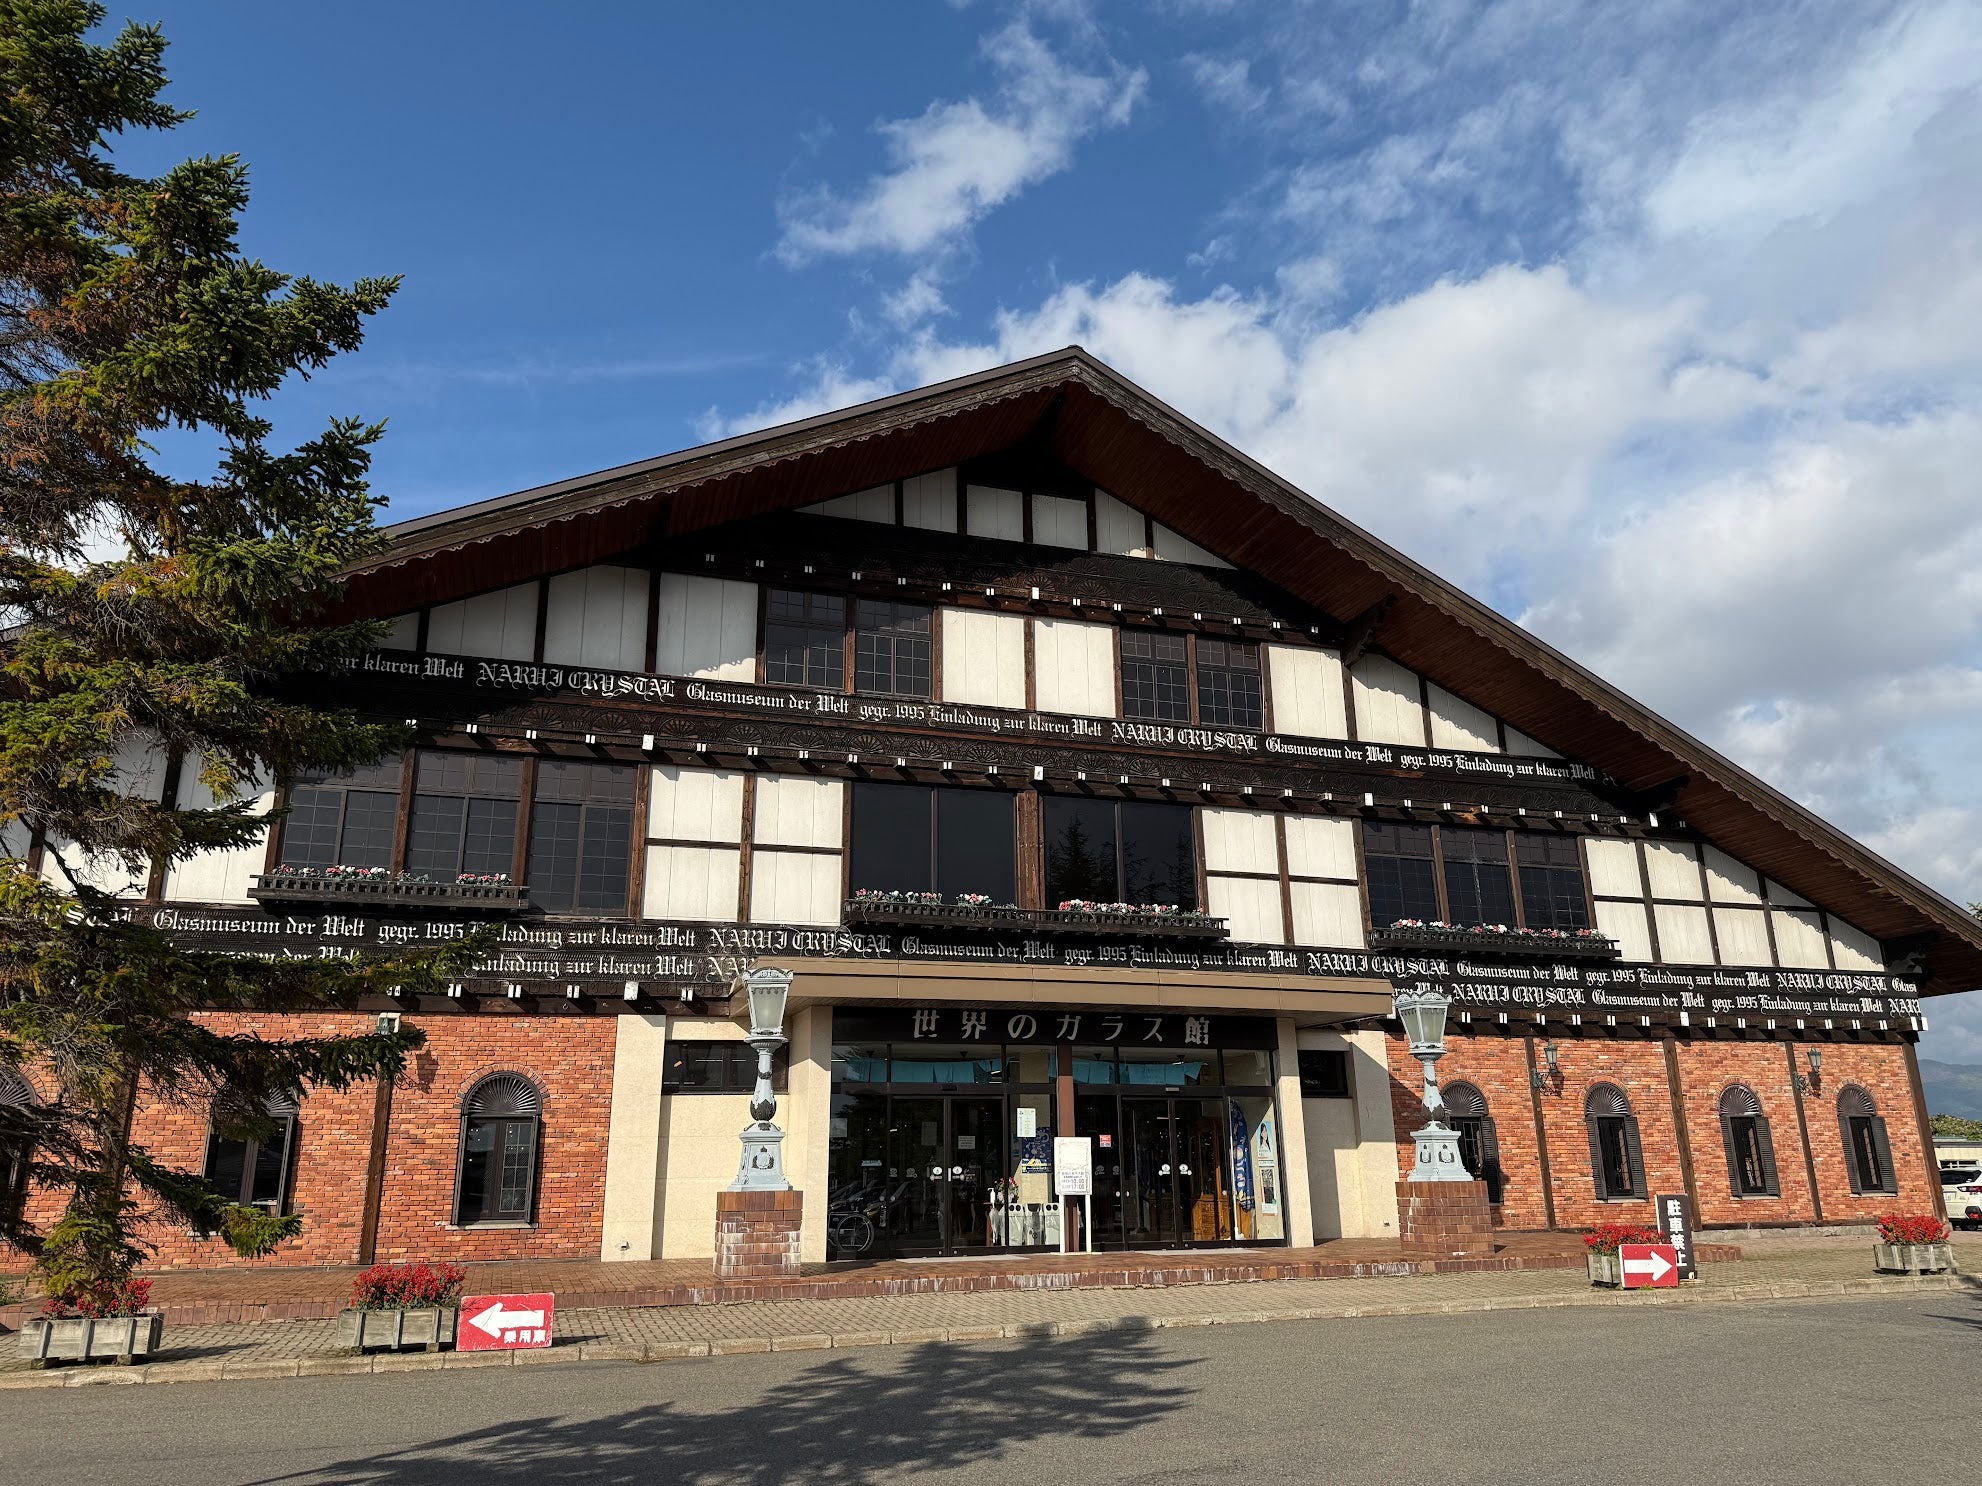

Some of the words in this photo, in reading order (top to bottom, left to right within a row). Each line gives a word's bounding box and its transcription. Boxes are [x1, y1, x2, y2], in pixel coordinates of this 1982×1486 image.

[337, 654, 359, 671] ur
[364, 654, 419, 674] klaren
[423, 655, 465, 679] Welt
[568, 672, 675, 702] CRYSTAL
[686, 682, 784, 708] Glasmuseum
[789, 695, 811, 710] der
[815, 693, 850, 715] Welt
[929, 702, 1000, 731] Einladung
[1004, 719, 1025, 729] zur
[1029, 714, 1070, 733] klaren
[1071, 717, 1101, 739] Welt
[1177, 728, 1258, 754] CRYSTAL
[1266, 735, 1343, 758] Glasmuseum
[1345, 746, 1362, 760] der
[1365, 746, 1392, 764] Welt
[1454, 752, 1514, 778] Einladung
[1516, 765, 1533, 774] zur
[1536, 762, 1569, 777] klaren
[1570, 764, 1595, 781] Welt
[153, 908, 279, 935] Glasmuseum
[285, 917, 316, 935] der
[320, 915, 365, 940] Welt
[565, 930, 598, 944] zur
[599, 924, 655, 945] klaren
[655, 927, 695, 950] Welt
[792, 931, 891, 958] CRYSTAL
[900, 938, 993, 959] Glasmuseum
[997, 942, 1018, 957] der
[1020, 941, 1054, 961] Welt
[1128, 945, 1199, 971] Einladung
[1203, 955, 1223, 965] zur
[1227, 948, 1266, 966] klaren
[1267, 950, 1298, 971] Welt
[1370, 956, 1450, 982] CRYSTAL
[1457, 961, 1530, 979] Glasmuseum
[1532, 966, 1550, 979] der
[1552, 965, 1578, 983] Welt
[1637, 967, 1694, 989] Einladung
[1695, 976, 1711, 985] zur
[1714, 971, 1747, 986] klaren
[1745, 972, 1770, 990] Welt
[1826, 975, 1887, 995] CRYSTAL
[566, 960, 594, 975] zur
[597, 956, 651, 975] klaren
[654, 955, 692, 977] Welt
[1512, 986, 1586, 1008] CRYSTAL
[1592, 989, 1660, 1006] Glasmuseum
[1662, 993, 1678, 1006] der
[1680, 992, 1705, 1011] Welt
[1758, 995, 1812, 1015] Einladung
[1811, 1002, 1828, 1012] zur
[1830, 997, 1861, 1012] klaren
[1859, 998, 1883, 1015] Welt
[912, 1009, 1210, 1045] 世界のガラス館
[1667, 1199, 1688, 1266] 駐車禁止
